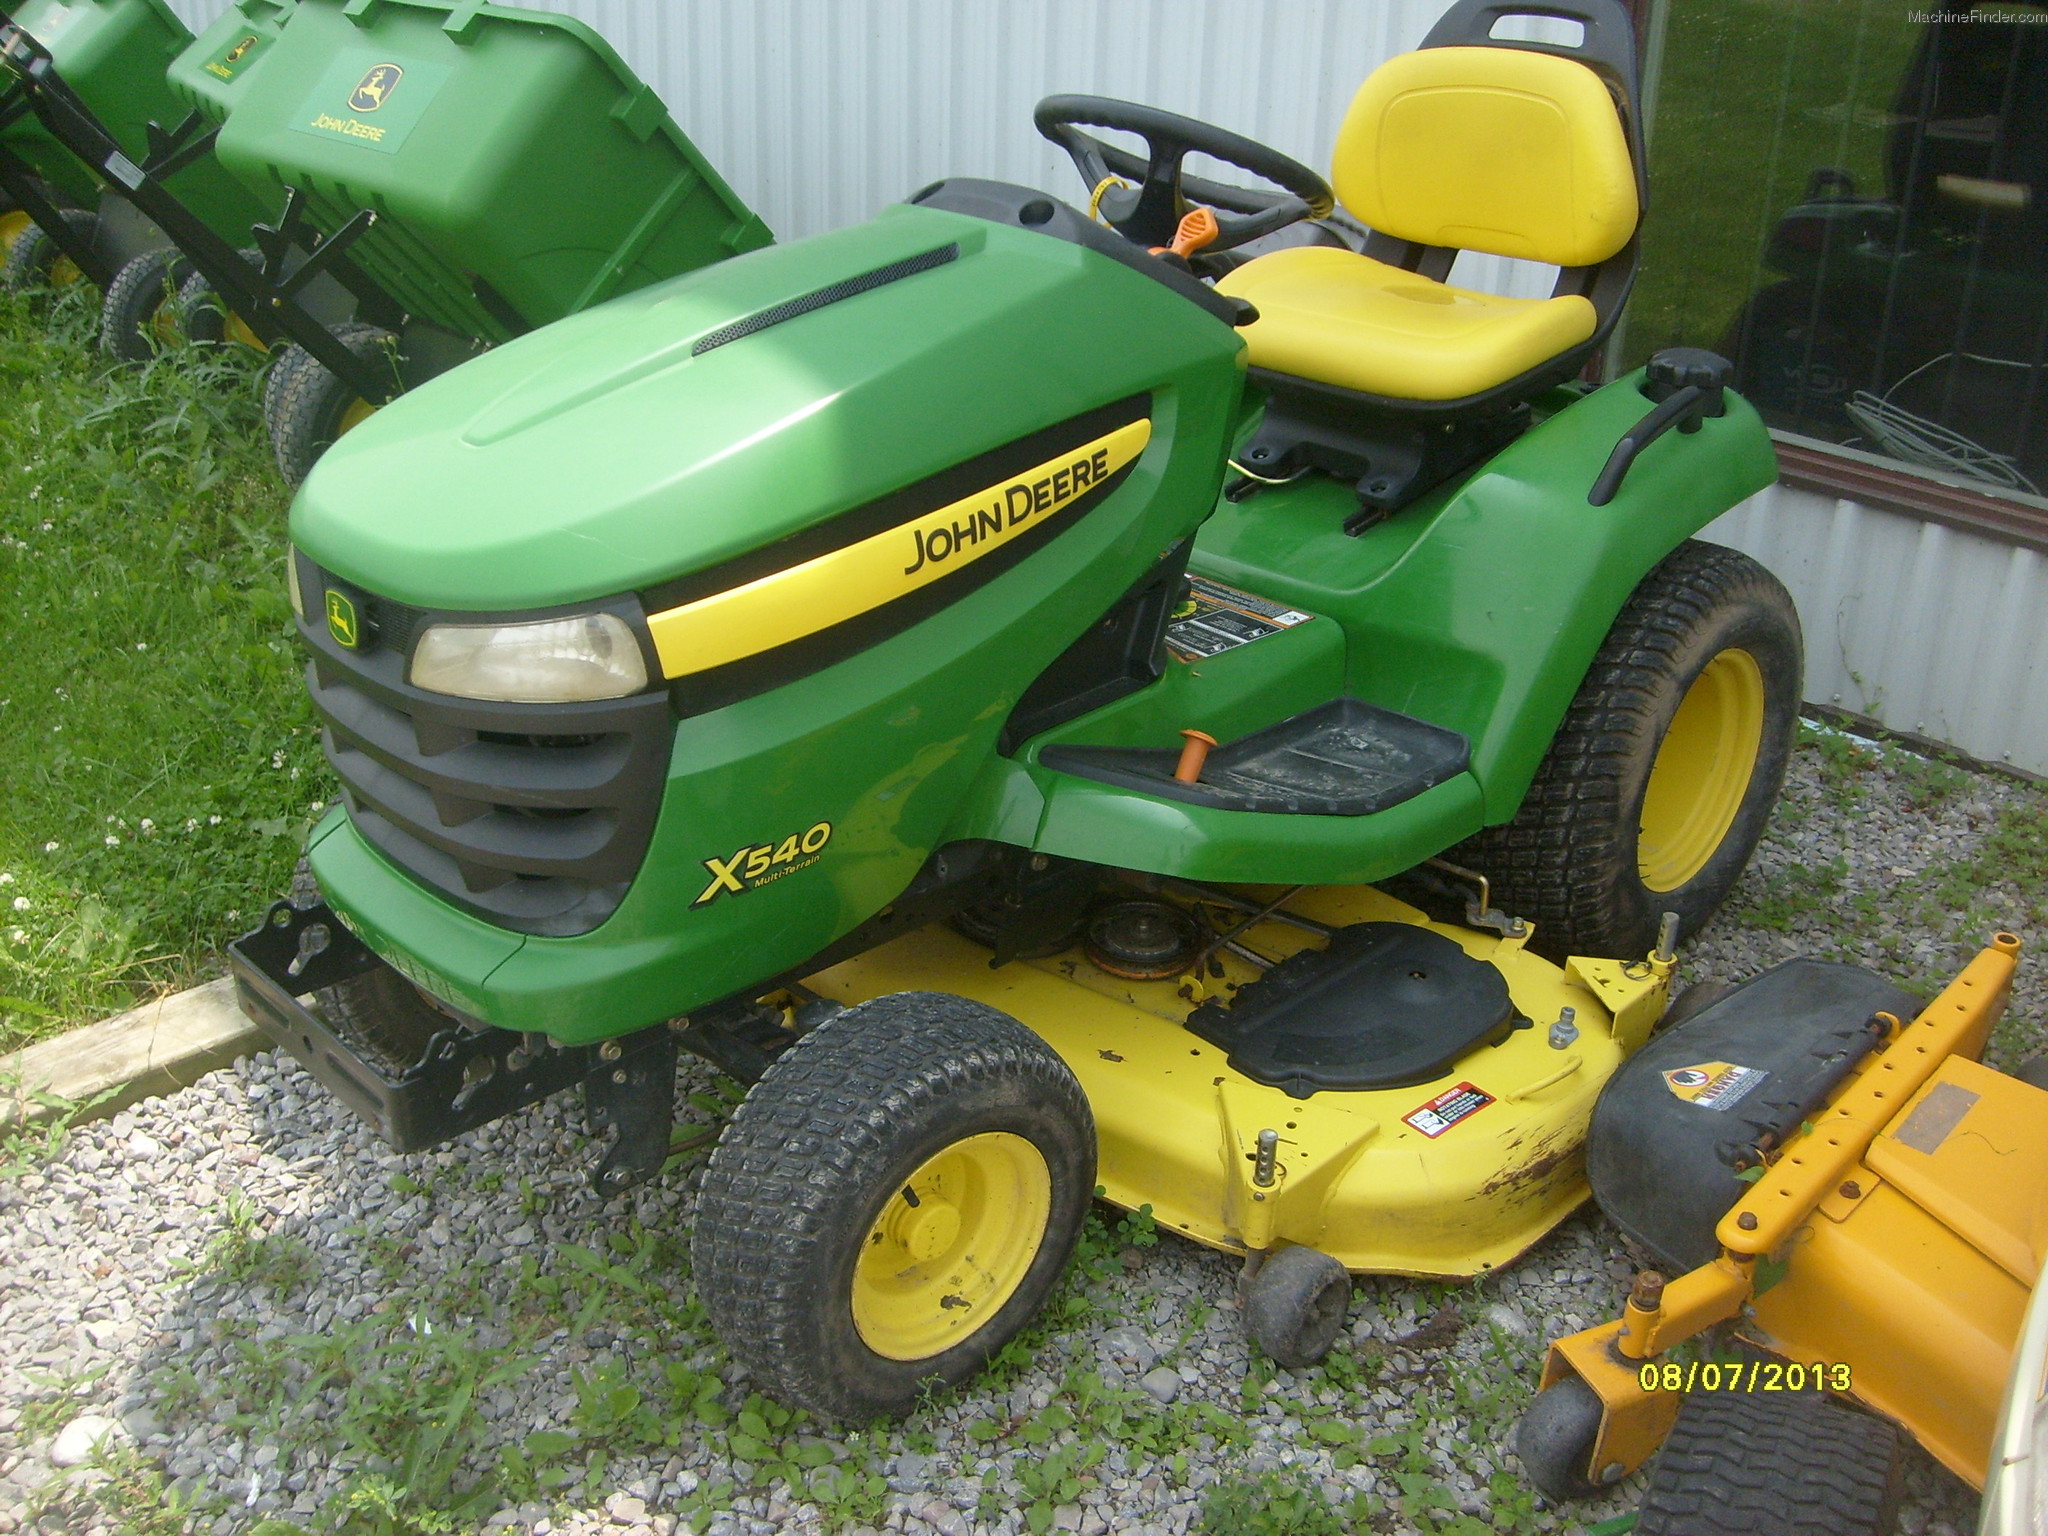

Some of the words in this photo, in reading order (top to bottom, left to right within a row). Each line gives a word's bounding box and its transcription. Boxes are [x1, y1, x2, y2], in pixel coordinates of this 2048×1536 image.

[311, 112, 346, 132] JOHN
[343, 118, 386, 142] DEERE
[904, 501, 1002, 576] JOHN
[1004, 447, 1109, 527] DEERE
[691, 821, 832, 909] X540
[754, 853, 821, 888] Multi-Terrain
